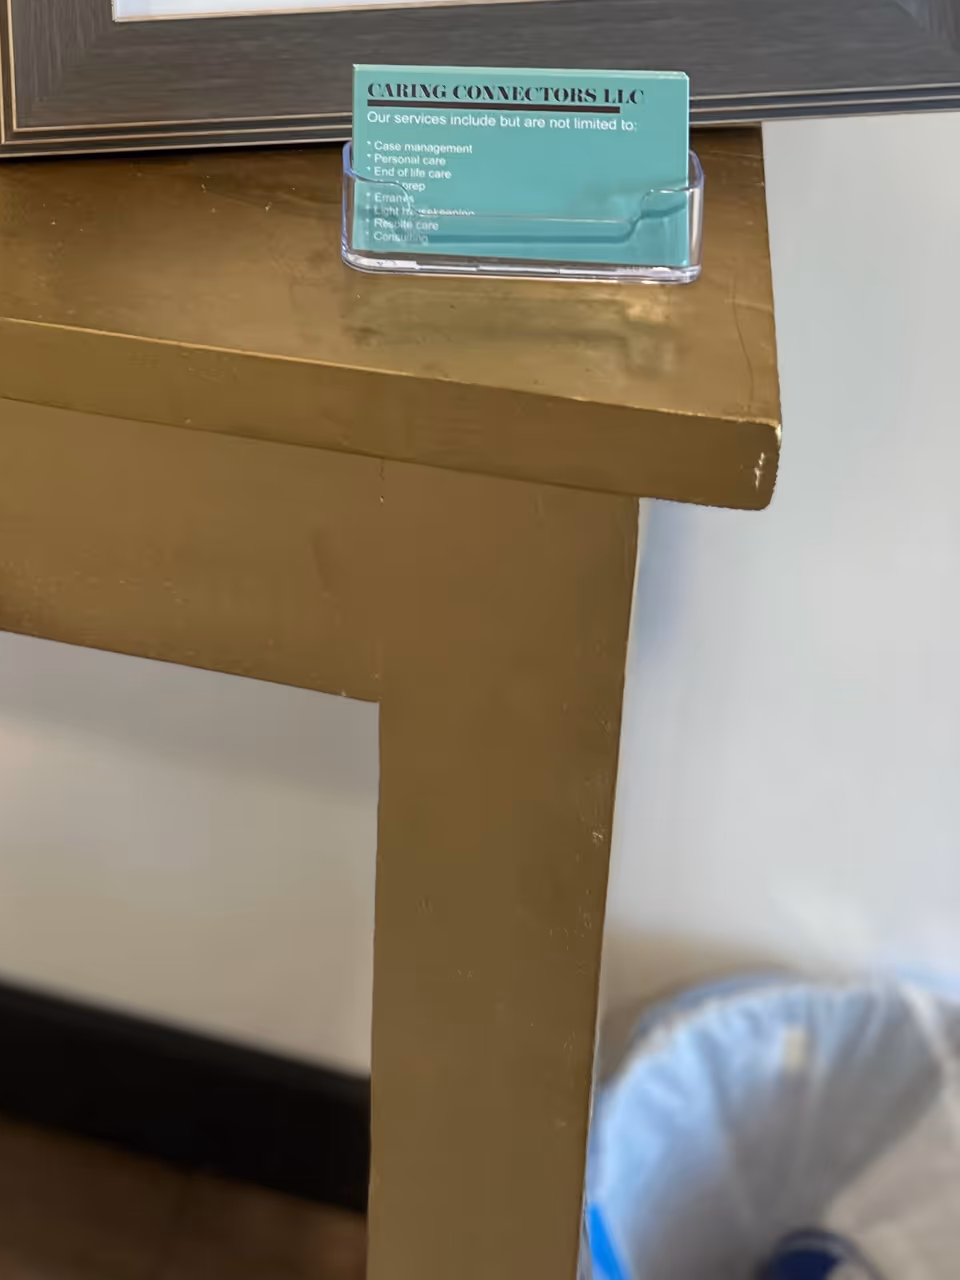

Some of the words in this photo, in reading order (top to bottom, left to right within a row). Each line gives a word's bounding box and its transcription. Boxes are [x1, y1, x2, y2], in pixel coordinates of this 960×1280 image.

[367, 82, 447, 99] CARING
[452, 84, 597, 104] CONNECTORS
[604, 89, 645, 105] LLC
[367, 111, 390, 124] Our
[393, 112, 446, 126] services
[450, 113, 496, 127] include
[499, 114, 520, 128] but
[524, 118, 546, 129] are
[549, 117, 571, 130] not
[574, 116, 617, 131] limited
[621, 117, 638, 132] to:
[374, 140, 402, 152] Case
[404, 144, 473, 155] management
[374, 154, 420, 165] Personal
[422, 156, 447, 166] care
[374, 166, 395, 178] End
[397, 167, 409, 178] of
[410, 167, 426, 179] life
[428, 170, 452, 180] care
[415, 221, 439, 231] care
